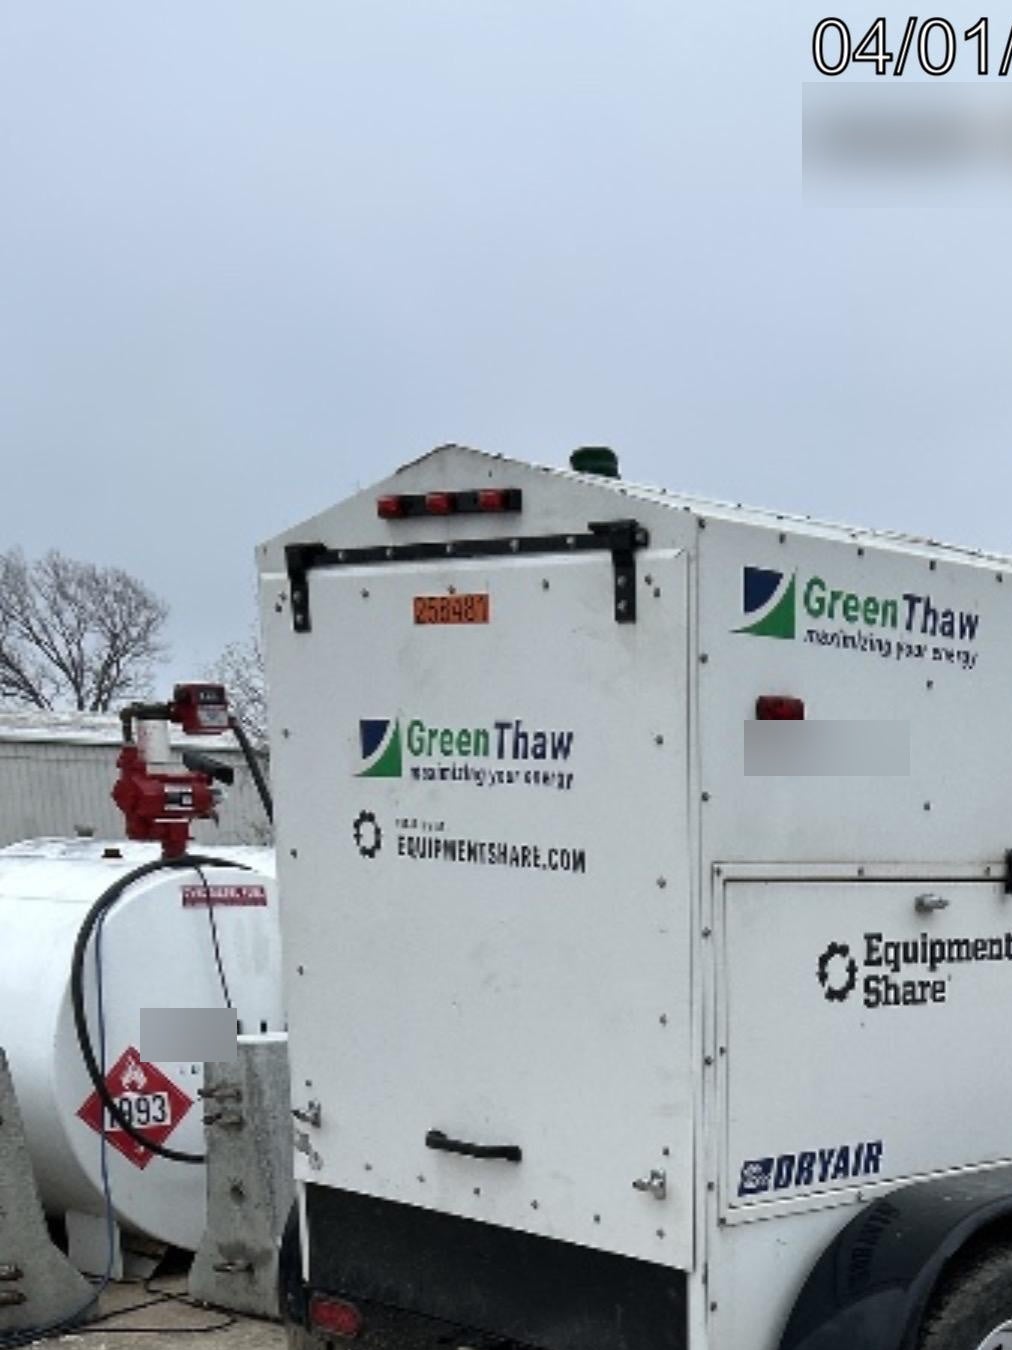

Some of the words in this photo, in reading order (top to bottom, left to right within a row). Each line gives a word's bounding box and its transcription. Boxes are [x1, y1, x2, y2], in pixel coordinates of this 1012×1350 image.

[803, 576, 979, 641] GreenThaw
[407, 719, 574, 761] GreenThaw
[397, 836, 586, 874] EQUIPMENTSHARE.COM
[863, 974, 946, 1009] Share
[774, 1139, 883, 1190] DRYAIR
